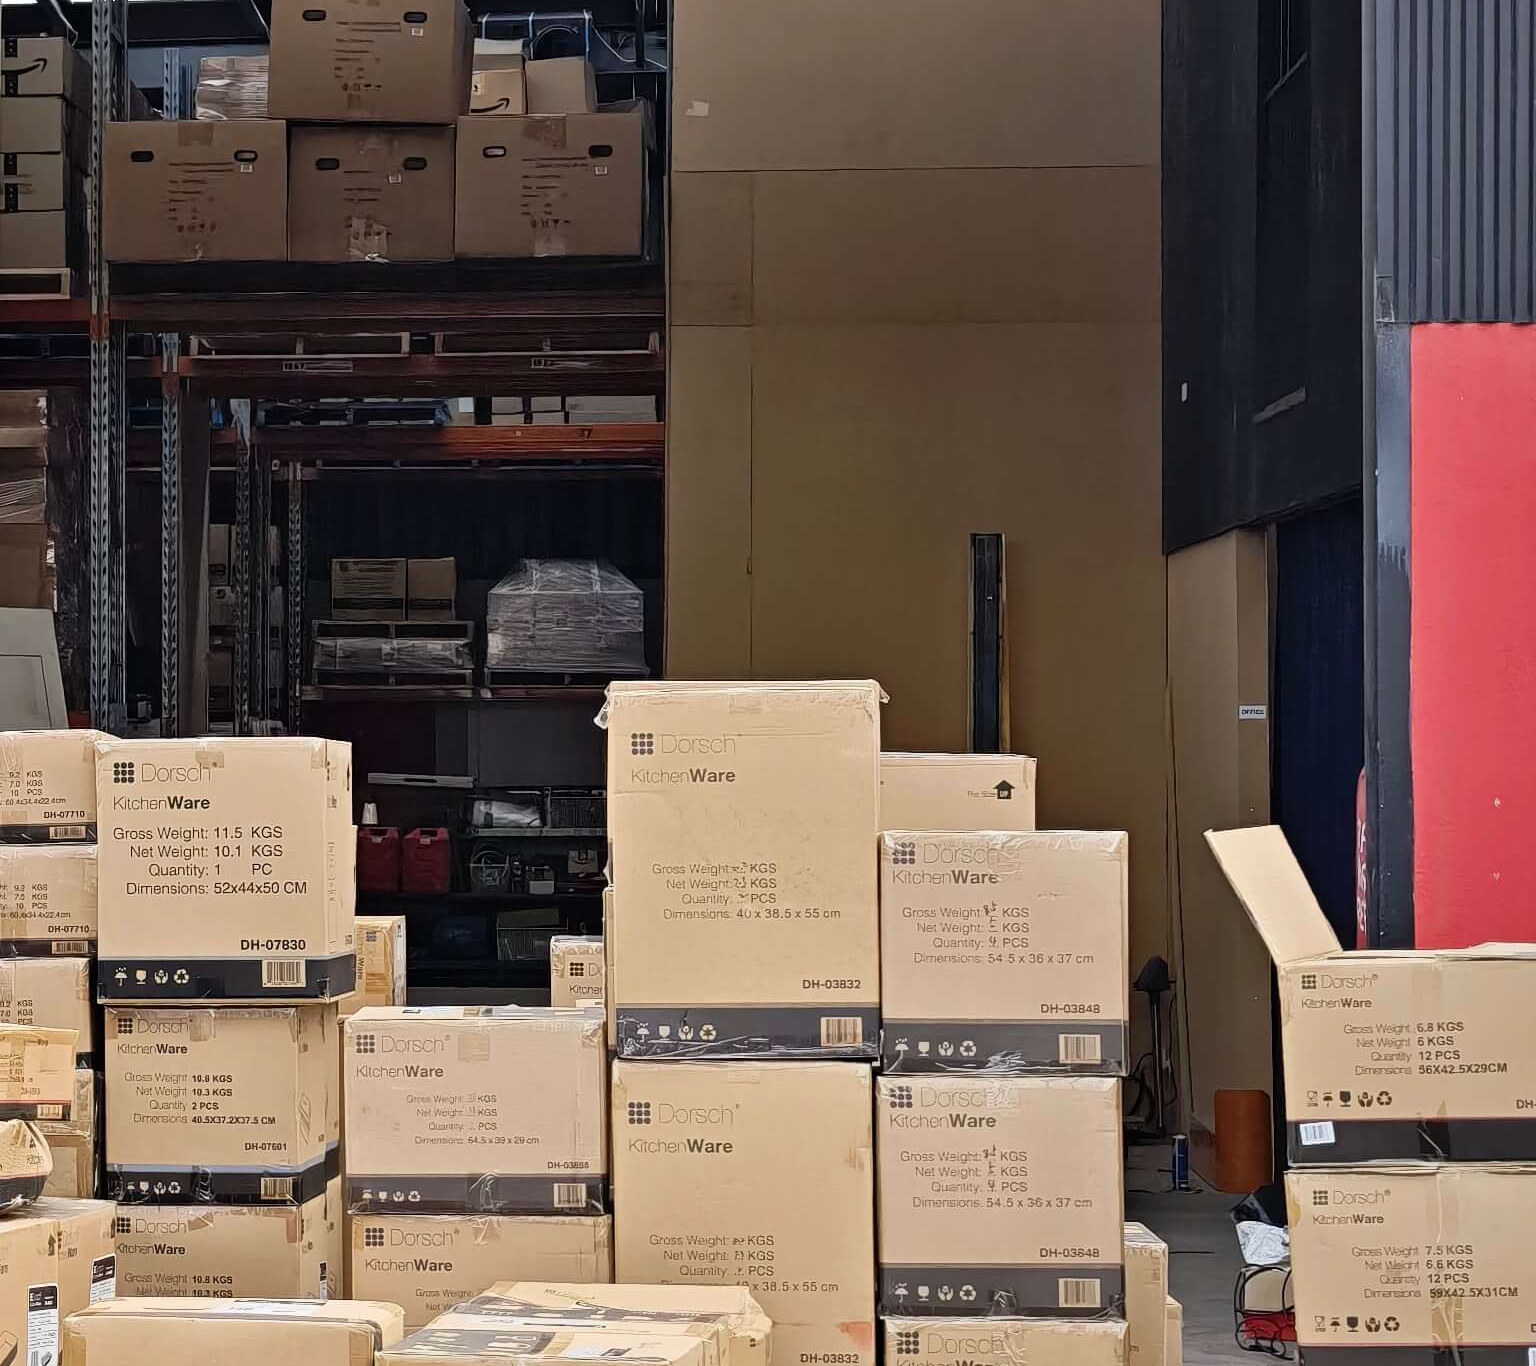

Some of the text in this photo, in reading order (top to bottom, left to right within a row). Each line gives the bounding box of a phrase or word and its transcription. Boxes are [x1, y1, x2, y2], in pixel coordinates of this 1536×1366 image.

[661, 734, 736, 754] Dorsch
[141, 763, 211, 782] Dorsch
[632, 768, 735, 783] KitchenWare
[113, 796, 210, 810] KitchenWare
[113, 826, 282, 841] Gross Weight: 11.5 KGS
[130, 845, 283, 859] Net Weight: 10.1 KGS
[149, 864, 272, 878] Quantity: 1 PC
[892, 870, 1000, 884] KitchenWare
[127, 881, 307, 895] Dimensions: 52x44x50 CM
[240, 939, 306, 951] DH-07830
[803, 979, 861, 989] DH-03832
[1041, 1004, 1100, 1013] DH-03848
[118, 1044, 188, 1054] KitchenWare
[1419, 1051, 1460, 1060] 12 PCS
[357, 1066, 444, 1078] KitchenWare
[659, 1104, 734, 1124] Dorsch
[629, 1139, 734, 1153] KitchenWare
